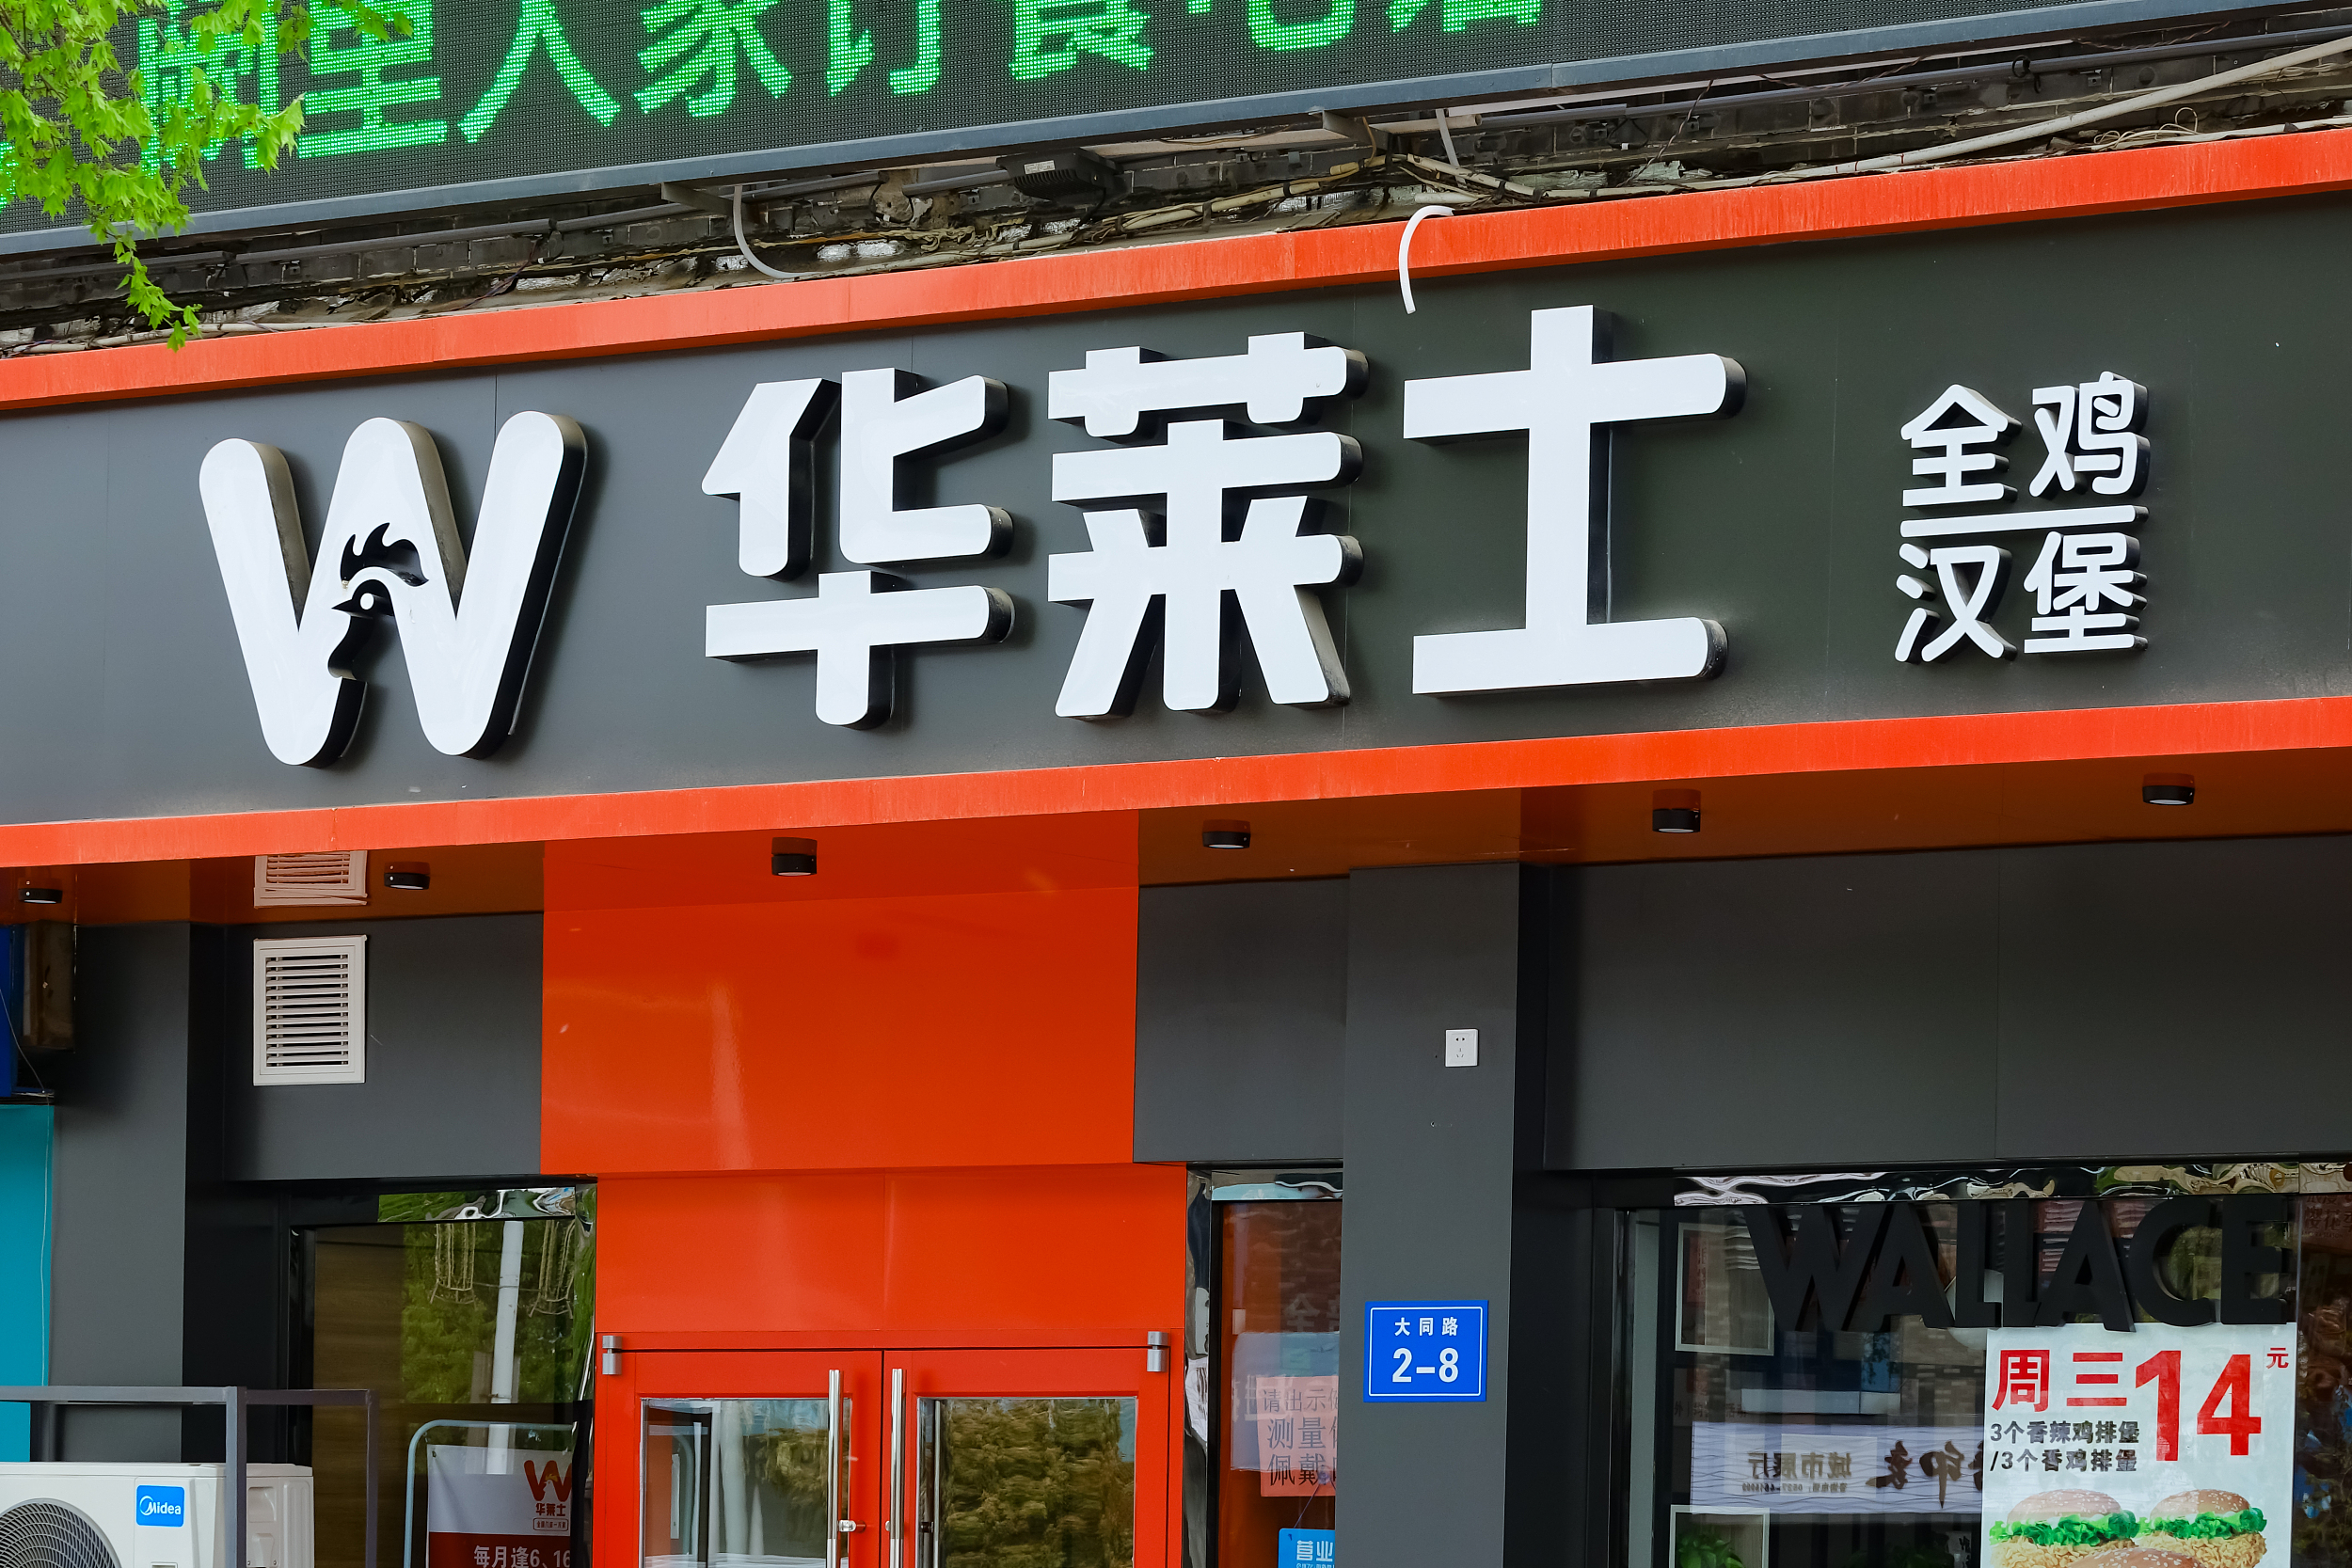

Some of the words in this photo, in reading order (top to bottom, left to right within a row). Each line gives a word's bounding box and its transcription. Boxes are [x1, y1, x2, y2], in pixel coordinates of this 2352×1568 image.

[1900, 372, 2150, 507] 全鸡
[701, 305, 1747, 727] 华莱士
[199, 411, 587, 768] W
[1895, 531, 2149, 662] 汉堡
[1742, 1196, 2292, 1333] WALLACE
[1394, 1317, 1458, 1337] 大同路
[1391, 1347, 1459, 1383] 2-8
[1992, 1349, 2127, 1412] 周三
[2135, 1350, 2262, 1462] 14
[2265, 1347, 2289, 1370] 元
[1990, 1420, 2140, 1444] 3个香辣鸡排堡
[1267, 1452, 1337, 1487] 佩戴
[1990, 1449, 2137, 1472] /3个香鸡排堡
[139, 1495, 182, 1516] Midea
[535, 1502, 566, 1517] 华莱士
[1296, 1540, 1334, 1562] 营业
